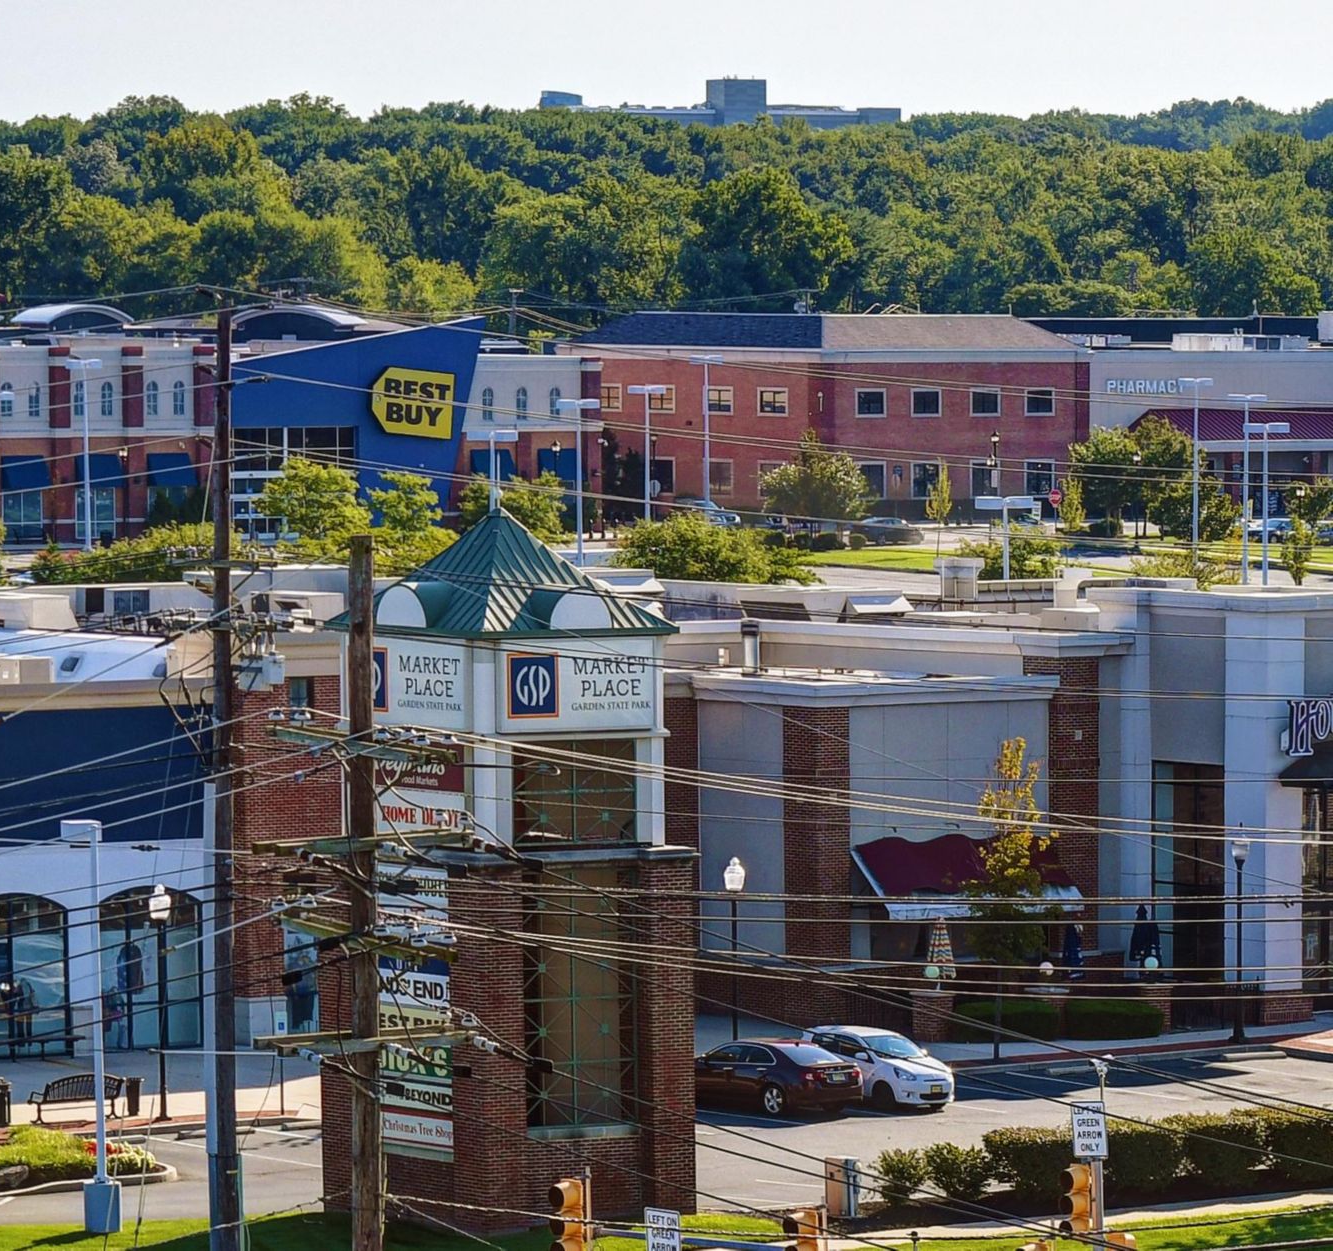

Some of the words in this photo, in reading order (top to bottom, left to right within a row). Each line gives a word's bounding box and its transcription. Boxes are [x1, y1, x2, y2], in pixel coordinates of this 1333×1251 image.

[383, 377, 451, 404] BEST
[385, 402, 444, 427] BUY
[398, 655, 461, 676] MARKET
[572, 656, 649, 676] MARKET
[404, 678, 454, 698] PLACE
[515, 664, 551, 707] GSP
[580, 678, 642, 698] PLACE
[397, 700, 426, 709] GARDEN
[426, 701, 444, 711] STATE
[445, 702, 462, 712] PARK
[570, 702, 605, 712] GARDEN
[606, 702, 631, 711] STATE
[632, 701, 651, 710] PARK
[381, 805, 417, 824] HOME
[413, 980, 445, 1000] END
[378, 1012, 410, 1029] EST
[405, 1088, 453, 1106] BEYOND
[383, 1119, 418, 1134] Christmas
[418, 1122, 434, 1137] Tree
[1077, 1119, 1100, 1128] GREEN
[1077, 1131, 1103, 1140] ARROW
[1080, 1143, 1100, 1152] ONLY
[648, 1214, 665, 1226] LEFT
[666, 1217, 678, 1227] ON
[652, 1228, 675, 1241] GREEN
